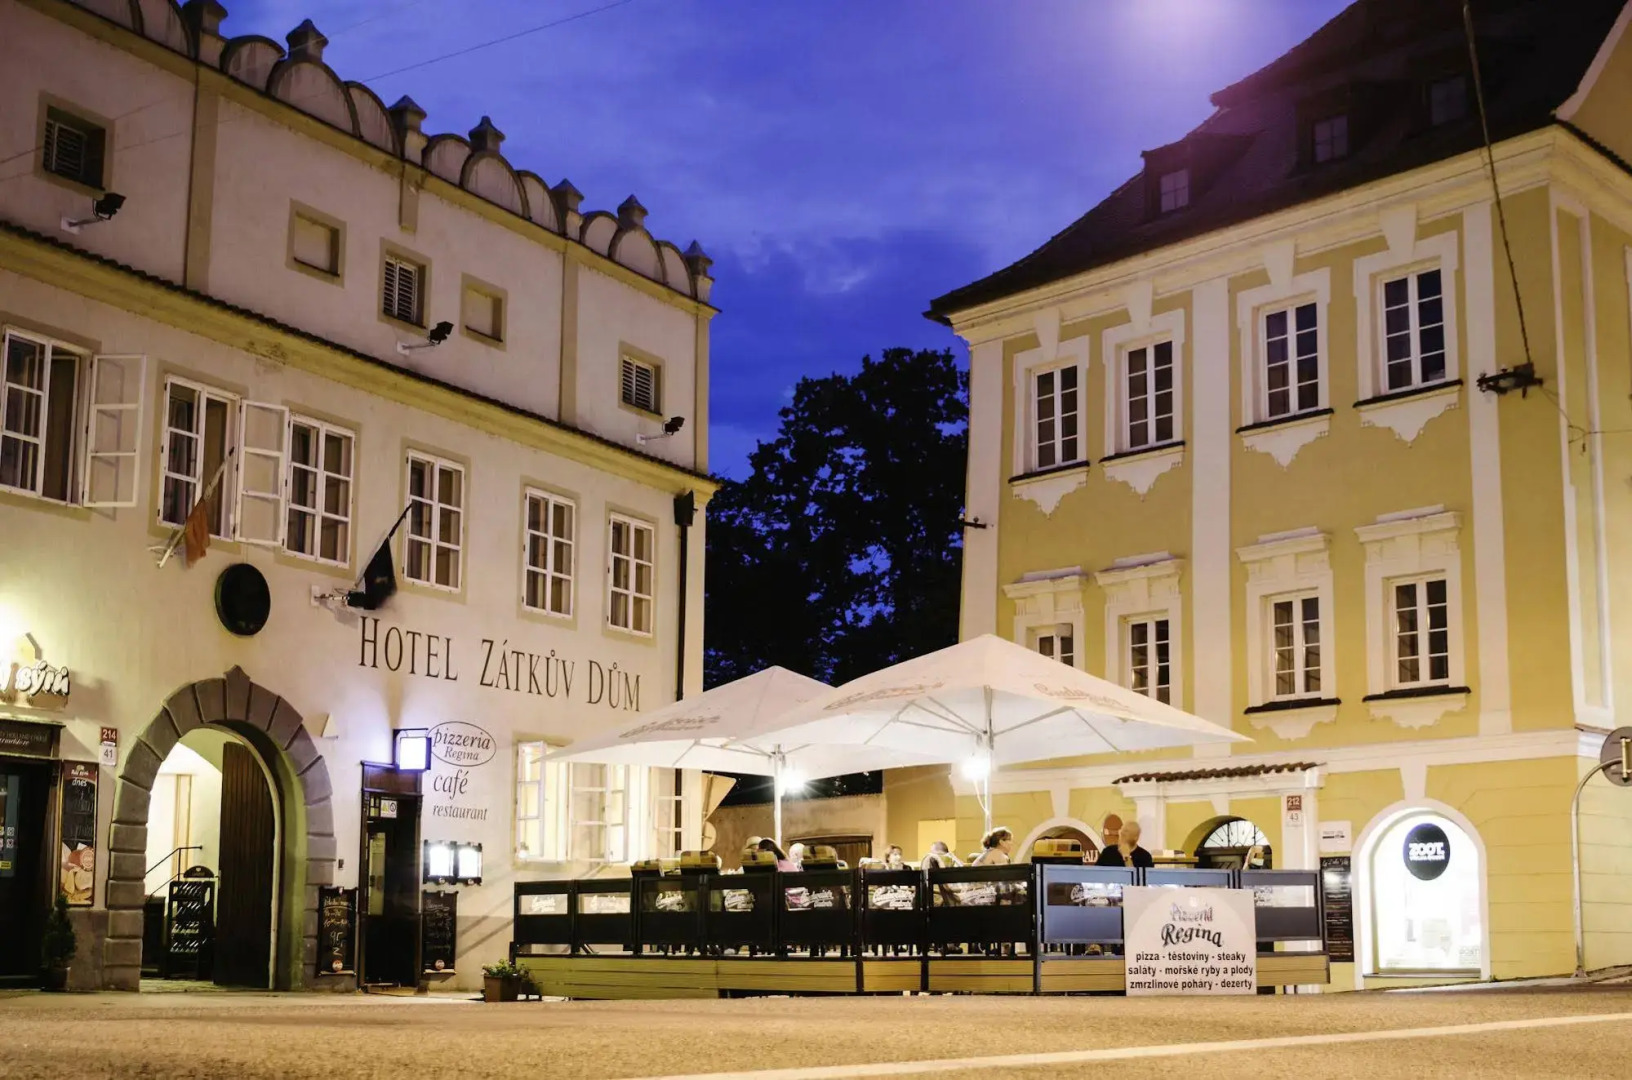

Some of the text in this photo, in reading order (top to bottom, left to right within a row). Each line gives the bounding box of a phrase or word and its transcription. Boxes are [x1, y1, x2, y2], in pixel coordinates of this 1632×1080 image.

[358, 615, 641, 712] HOTEL ZÁTKŮV DŮM
[102, 728, 117, 740] 214
[432, 727, 491, 751] pizzeria
[103, 748, 114, 759] 41
[444, 745, 480, 761] Regina
[433, 768, 470, 800] café
[1287, 797, 1300, 806] 212
[432, 803, 488, 820] restaurant
[1289, 813, 1299, 821] 43
[1160, 923, 1223, 948] Regina
[1136, 951, 1160, 962] pizza
[1168, 951, 1210, 963] těstoviny
[1217, 951, 1246, 962] steaky
[1128, 965, 1157, 977] saláty
[1165, 965, 1199, 975] mořské
[1201, 965, 1221, 976] ryby
[1223, 967, 1228, 975] a
[1230, 965, 1254, 976] plody
[1130, 979, 1179, 989] zmrzlinové
[1181, 979, 1213, 990] poháry
[1220, 979, 1253, 990] dezerty
